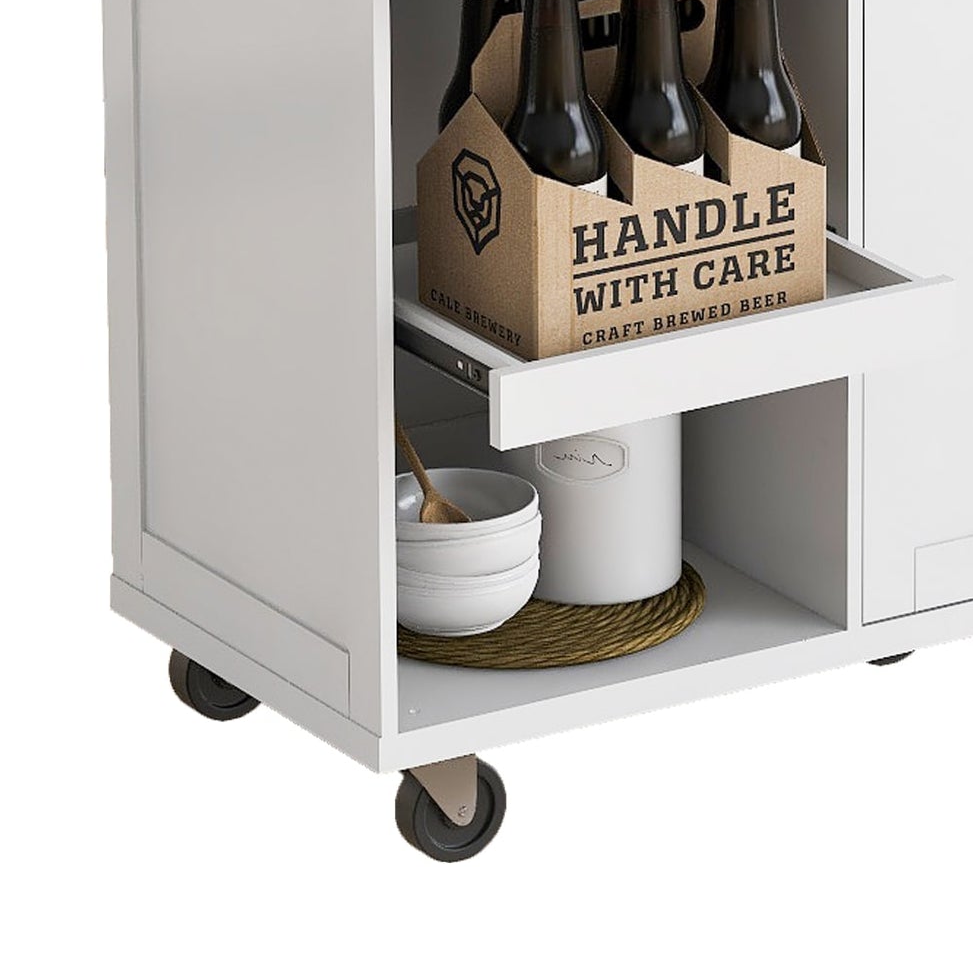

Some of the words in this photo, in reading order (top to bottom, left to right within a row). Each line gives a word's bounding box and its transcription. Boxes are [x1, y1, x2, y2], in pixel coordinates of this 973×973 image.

[572, 182, 795, 266] HANDLE
[573, 267, 679, 316] WITH
[693, 243, 795, 290] CARE
[430, 288, 460, 314] CALE
[465, 306, 521, 346] BREWERY
[582, 321, 645, 346] CRAFT
[653, 303, 731, 331] BREWED
[740, 290, 787, 313] BEER
